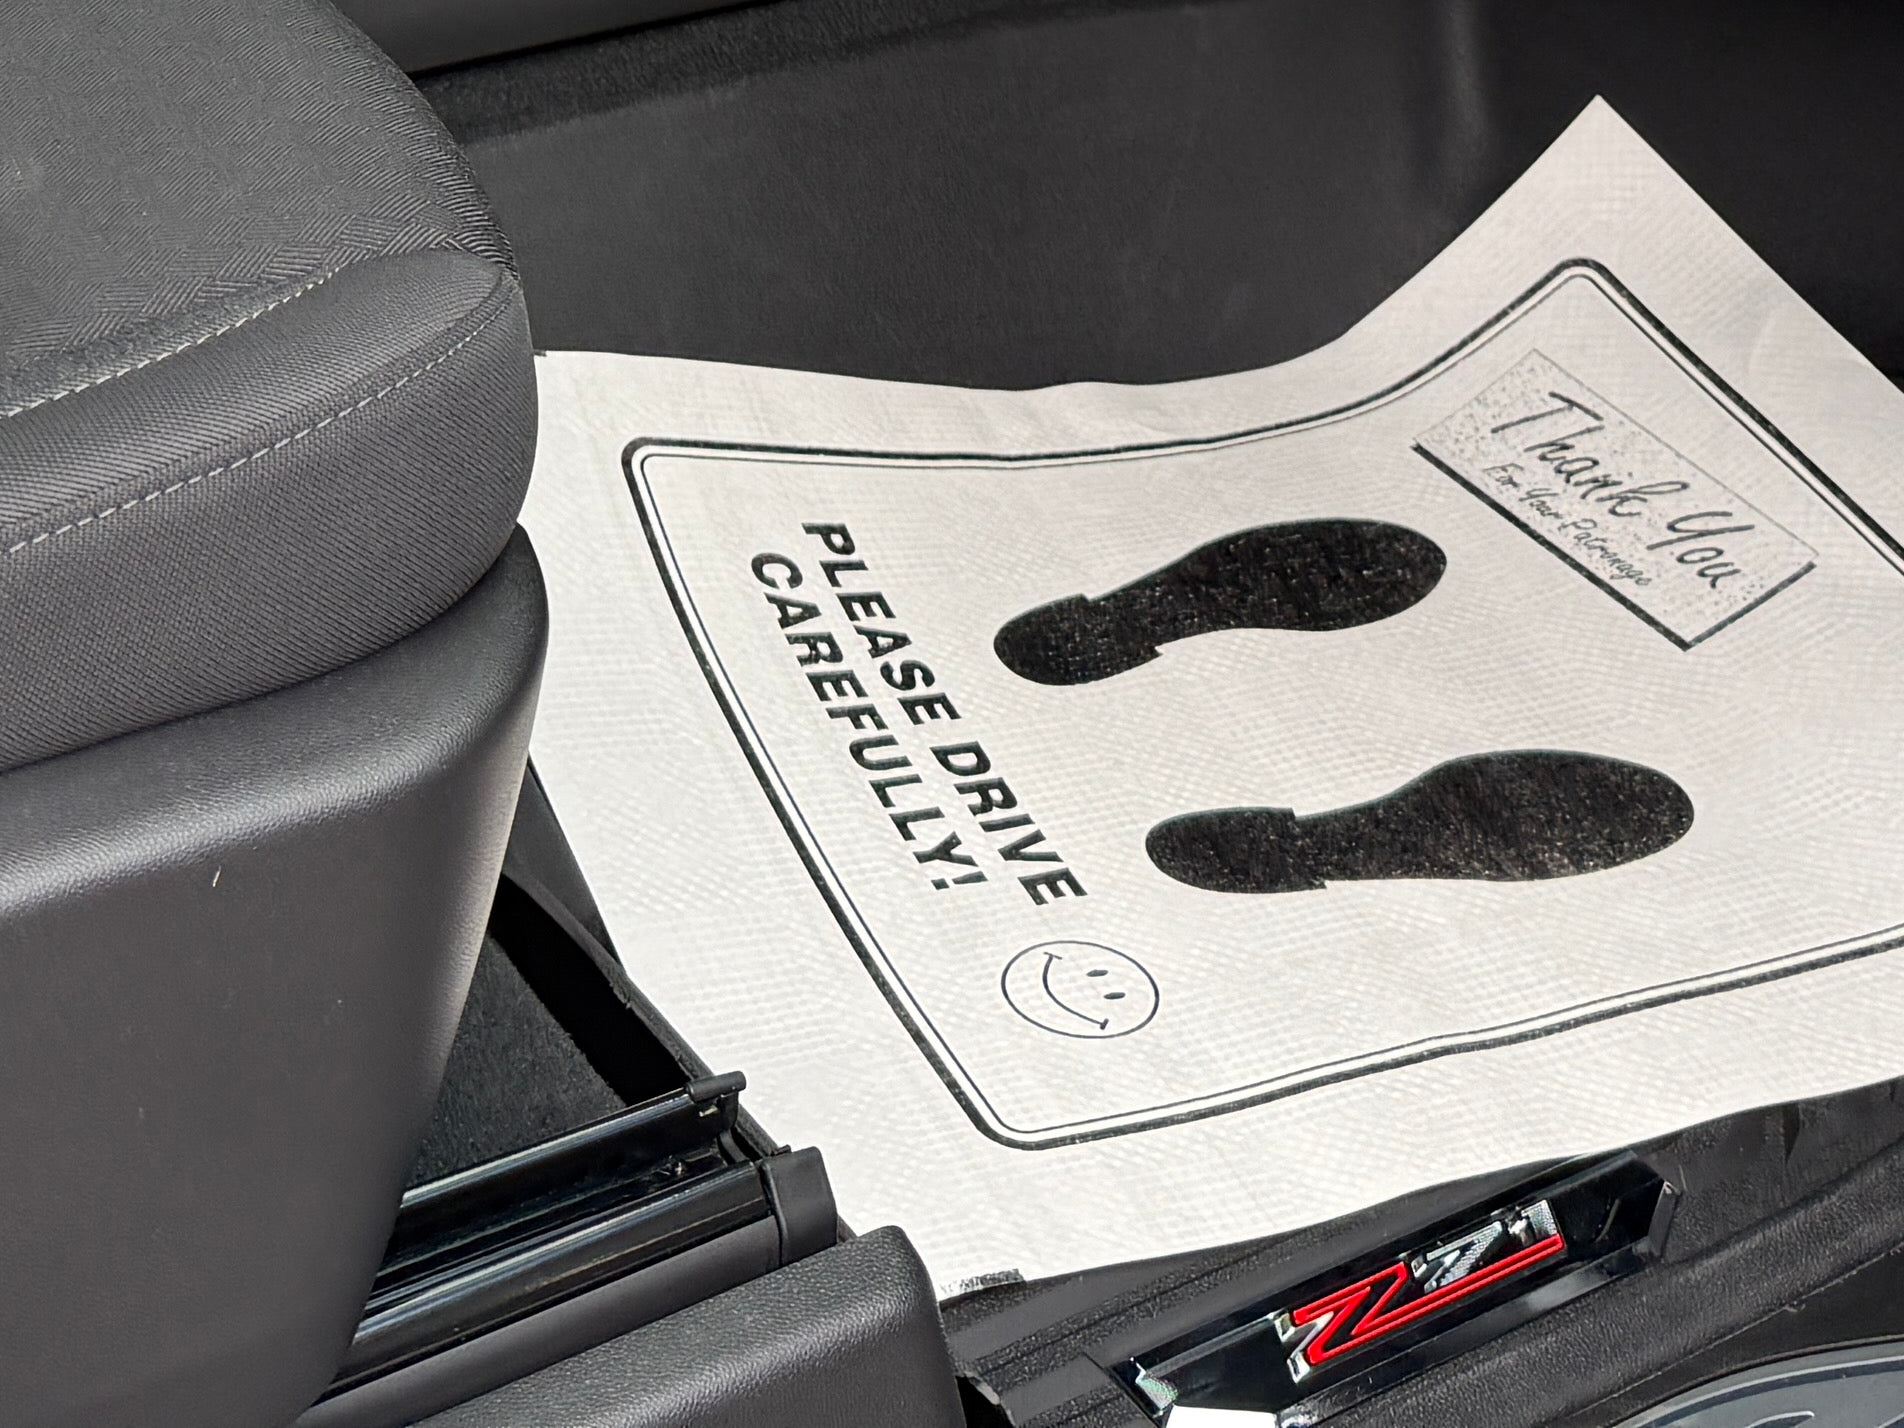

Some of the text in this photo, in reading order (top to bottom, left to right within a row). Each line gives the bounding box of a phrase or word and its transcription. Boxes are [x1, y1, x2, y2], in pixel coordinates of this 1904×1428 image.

[1483, 462, 1652, 588] For Your Patronage
[1490, 391, 1755, 590] Thank You
[751, 552, 988, 891] CAREFULLY!
[801, 521, 1088, 907] PLEASE DRIVE
